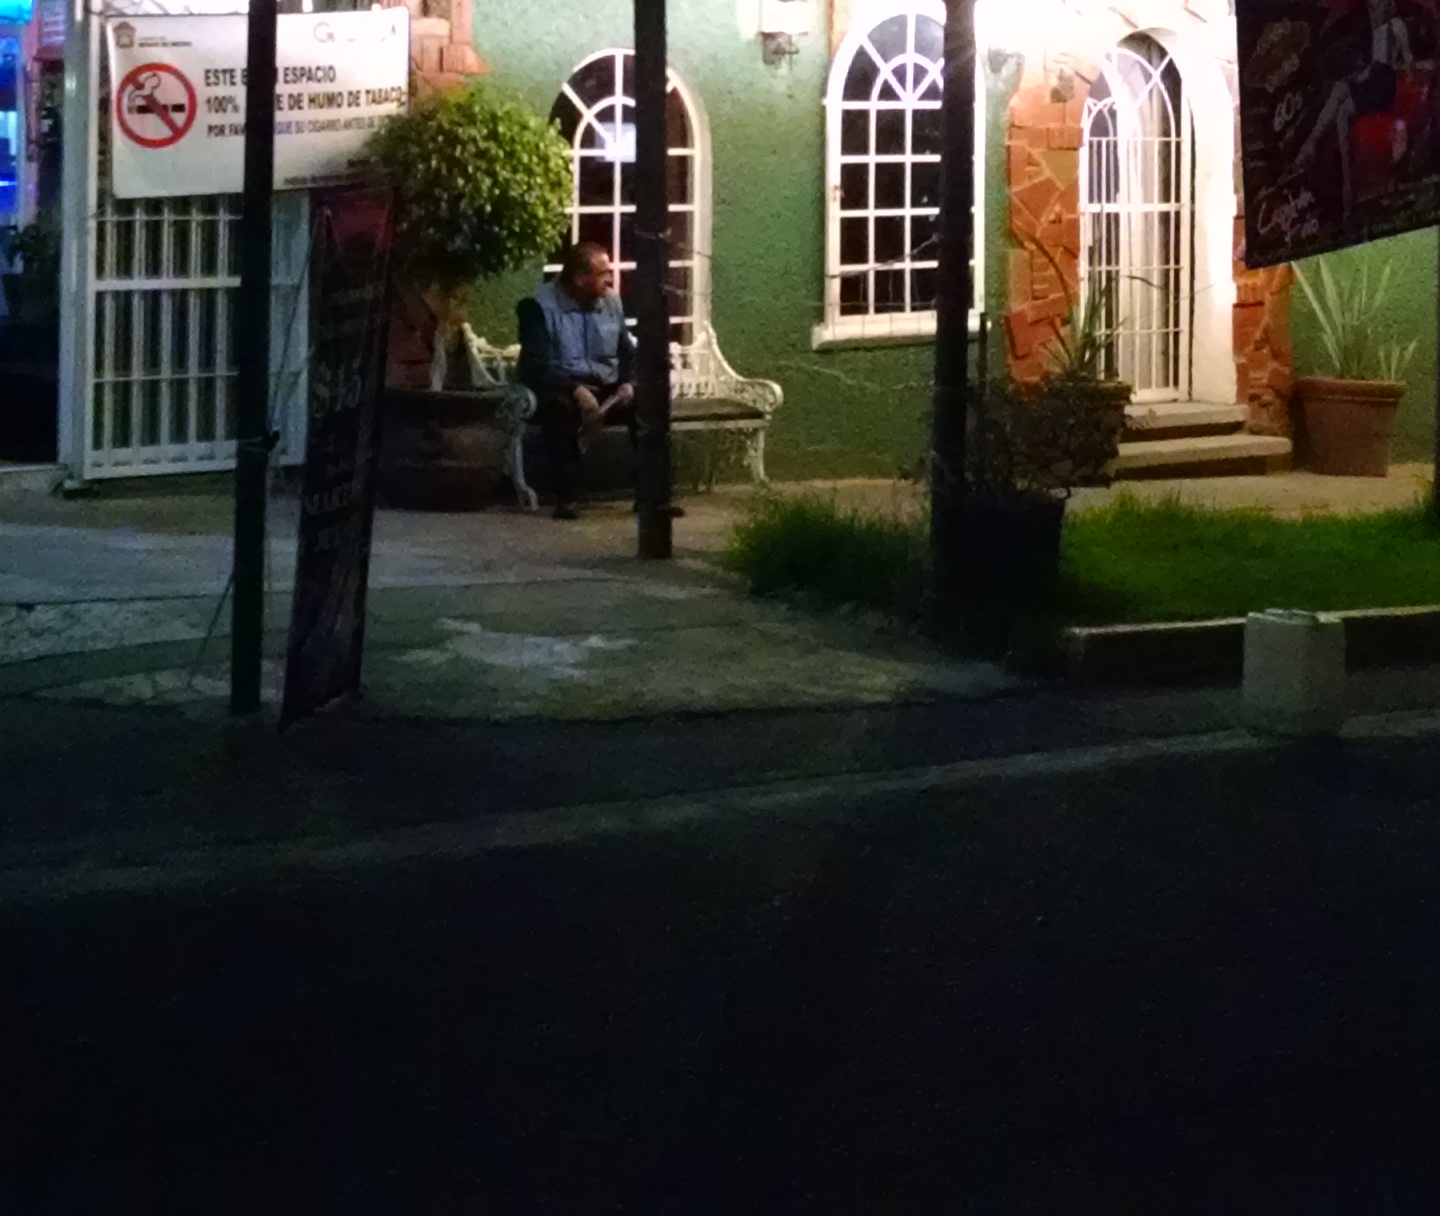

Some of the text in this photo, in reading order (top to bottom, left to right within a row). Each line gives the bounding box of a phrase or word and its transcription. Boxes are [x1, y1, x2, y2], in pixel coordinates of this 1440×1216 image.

[204, 68, 237, 87] ESTE
[283, 64, 337, 85] ESPACIO
[206, 95, 240, 114] 100%
[288, 92, 305, 111] DE
[308, 91, 344, 110] HUMO
[347, 89, 362, 108] DE
[365, 85, 403, 106] TABACO
[207, 124, 225, 137] POR
